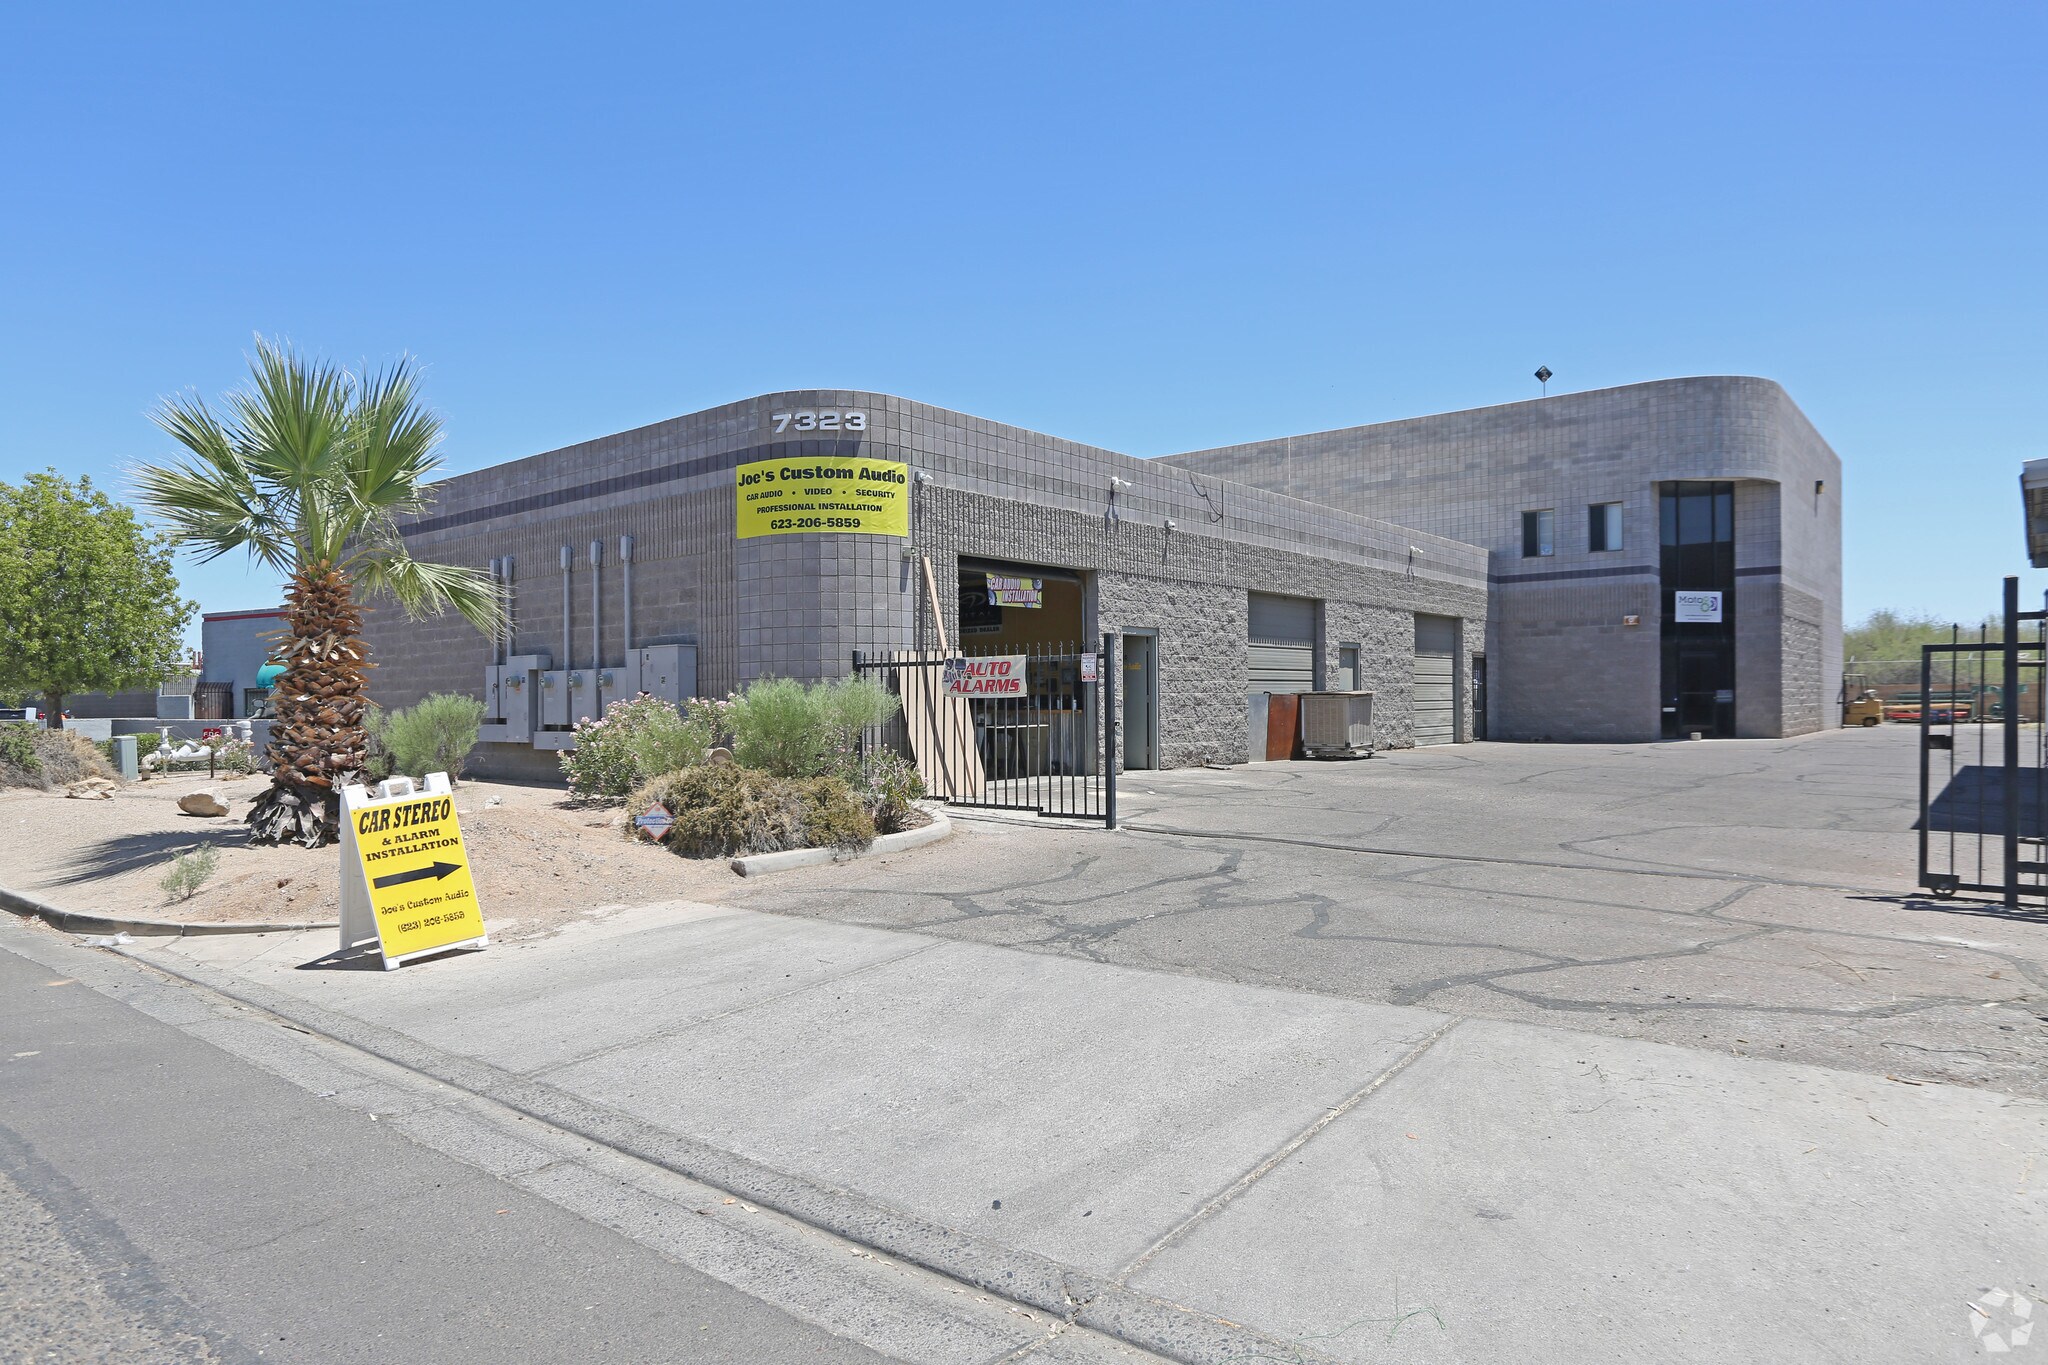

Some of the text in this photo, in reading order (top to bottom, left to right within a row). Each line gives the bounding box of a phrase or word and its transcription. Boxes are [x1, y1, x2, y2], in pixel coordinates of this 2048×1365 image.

[772, 411, 866, 433] 7323
[738, 465, 906, 487] Joe's Custom Audio
[746, 487, 896, 502] CAR AUDIO VIDEO SECURITY
[757, 502, 883, 514] PROFESSIONAL INSTALLATION
[770, 517, 861, 530] 623-206-5859
[990, 578, 1021, 591] CAR AUDIO
[1002, 590, 1038, 603] INSTALLATION
[963, 661, 1012, 677] AUTO
[949, 678, 1021, 694] ALARMS
[359, 798, 451, 835] CAR STEREO
[382, 828, 440, 846] & ALARM
[365, 837, 459, 862] INSTALLATION
[381, 889, 469, 916] Joe's Custom Audio
[397, 910, 466, 933] (623) 206-5859
